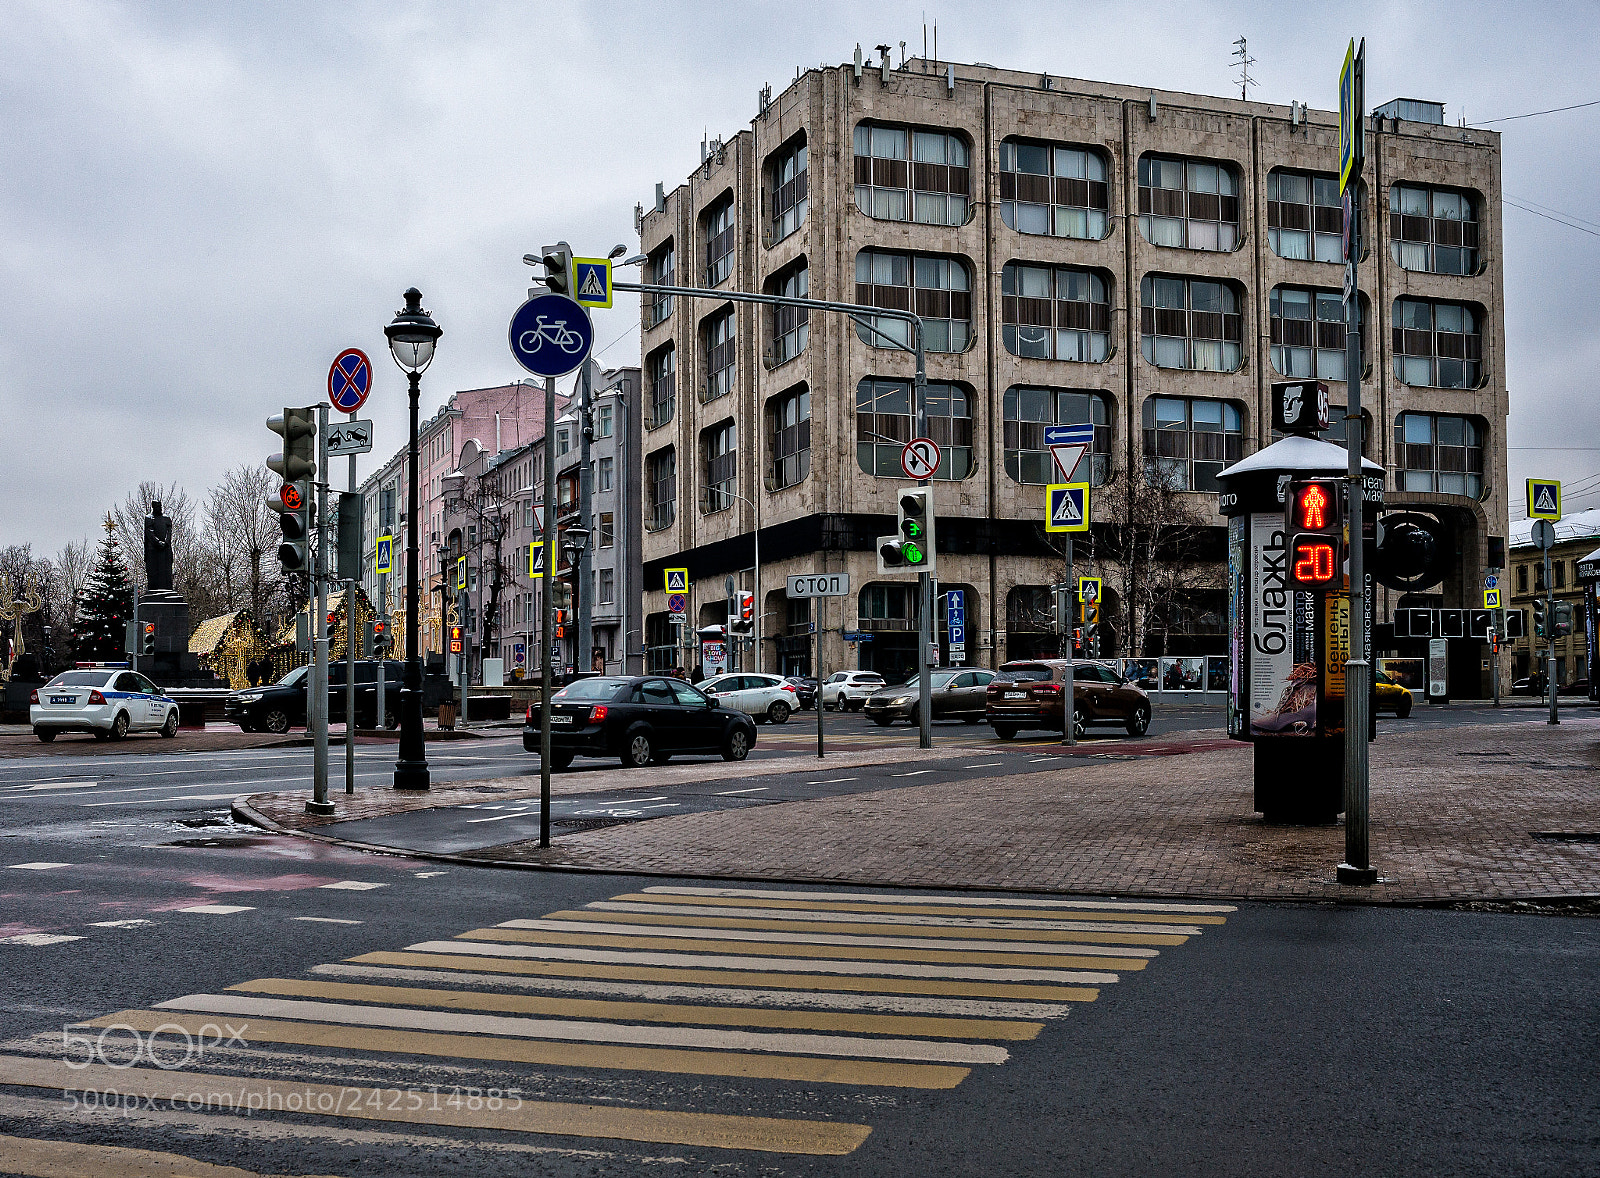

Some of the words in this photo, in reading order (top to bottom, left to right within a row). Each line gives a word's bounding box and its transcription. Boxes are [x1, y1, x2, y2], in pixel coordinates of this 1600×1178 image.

[1317, 389, 1329, 424] 95
[1295, 545, 1333, 580] 20
[795, 577, 840, 594] СТОП
[1253, 530, 1287, 655] блажь
[1295, 591, 1306, 631] театр
[451, 642, 462, 652] 60
[952, 627, 962, 642] P
